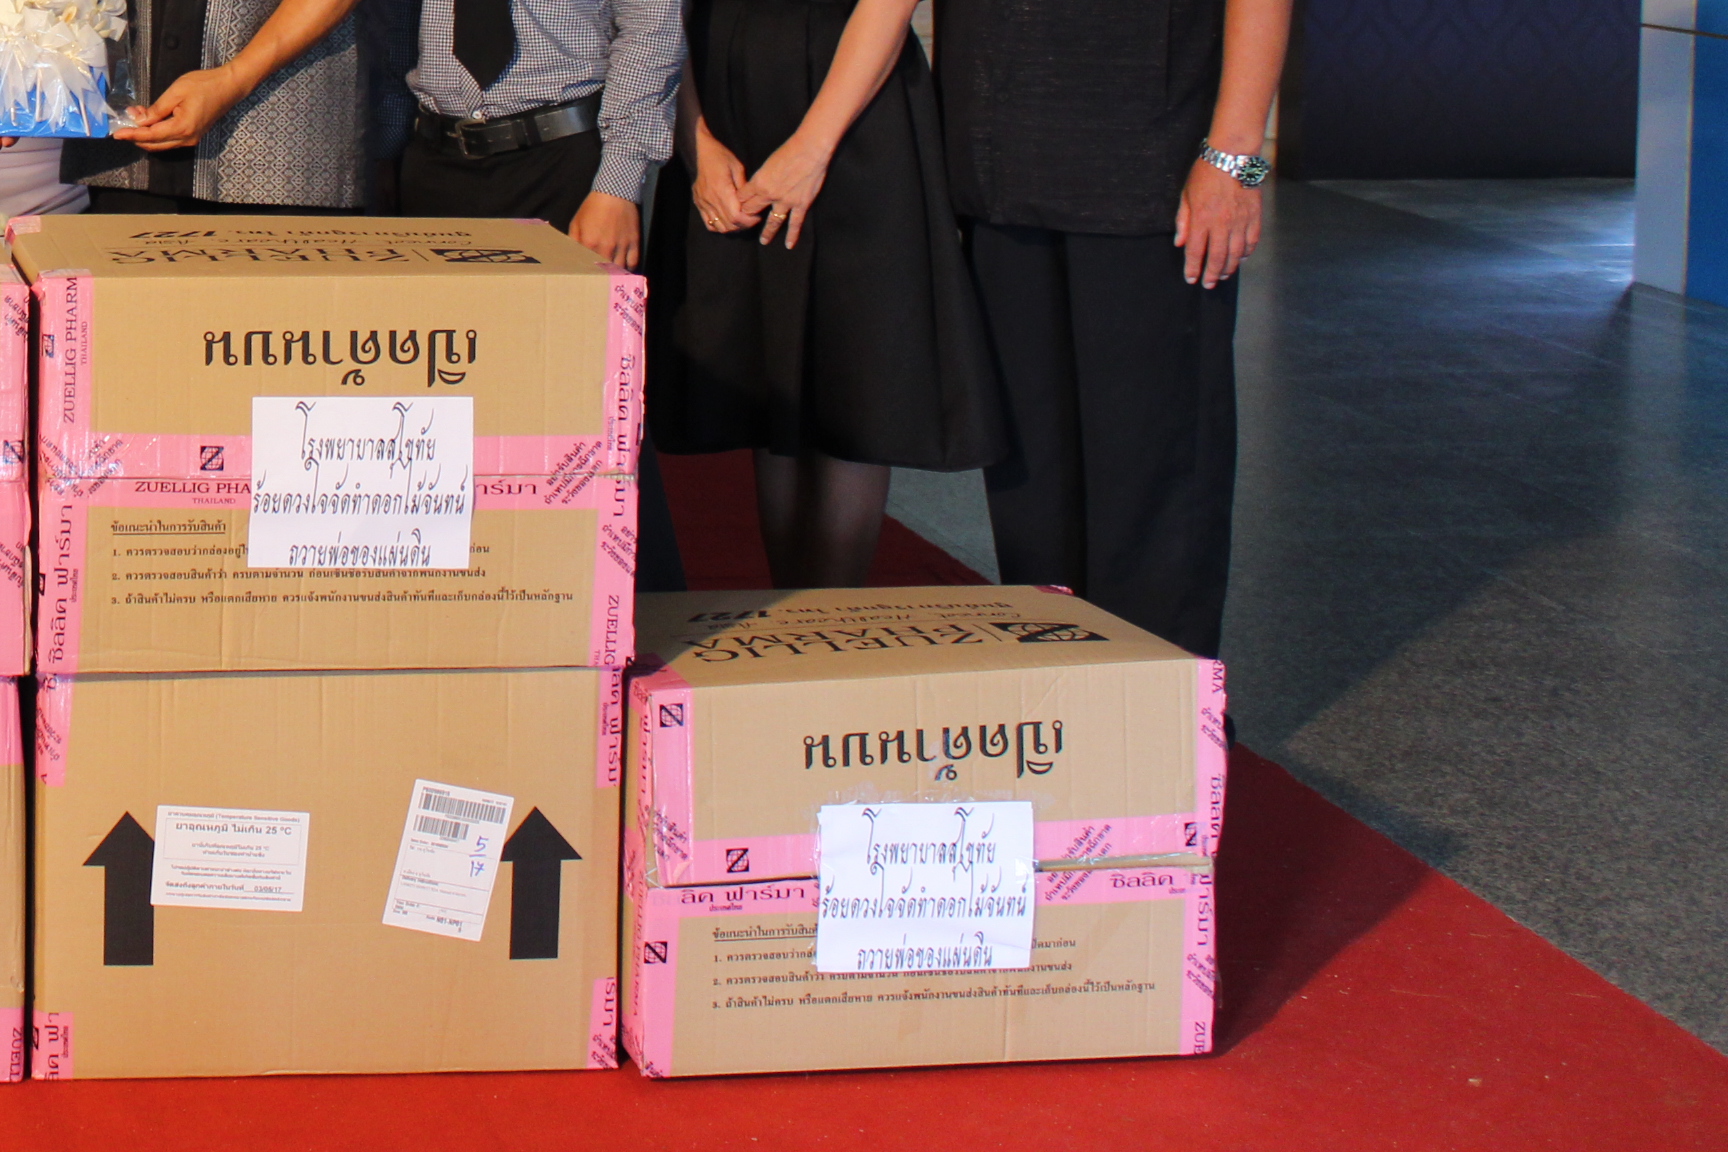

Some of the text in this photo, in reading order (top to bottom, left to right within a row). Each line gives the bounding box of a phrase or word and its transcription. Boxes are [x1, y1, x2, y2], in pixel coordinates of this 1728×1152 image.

[203, 328, 478, 388] เปิดด้านบน
[64, 349, 76, 423] ZUELLIG
[295, 401, 436, 479] โรงพยาบาลสุโขทัย
[135, 482, 251, 494] ZUELLIG PHA
[253, 457, 468, 514] ร้อยดวงใจจัดทำดอกไม้จันทน์
[475, 479, 536, 495] าร์มา
[111, 519, 226, 532] ข้อแนะนำในการรับสินค้า
[54, 505, 72, 586] ฟาร์มา
[289, 528, 432, 566] ถวายพ่อของแผ่นดิน
[48, 599, 67, 663] ซิลลิค
[604, 595, 619, 666] ZUELLIG
[688, 609, 771, 623] 1727
[685, 623, 967, 649] PHARMA
[694, 632, 983, 663] ZUELLIG
[803, 718, 1064, 781] เปิดด้านบน
[176, 822, 228, 834] ยาอุณหภูมิ
[231, 823, 262, 834] ไม่เกิน
[265, 826, 278, 834] 25
[862, 807, 996, 882] โรงพยาบาลสุโขทัย
[681, 885, 805, 904] ลิค ฟาร์มา
[821, 861, 1029, 918] ร้อยดวงใจจัดทำดอกไม้จันทน์
[1109, 872, 1174, 889] ซิลลิค
[857, 931, 994, 970] ถวายพ่อของแผ่นดิน
